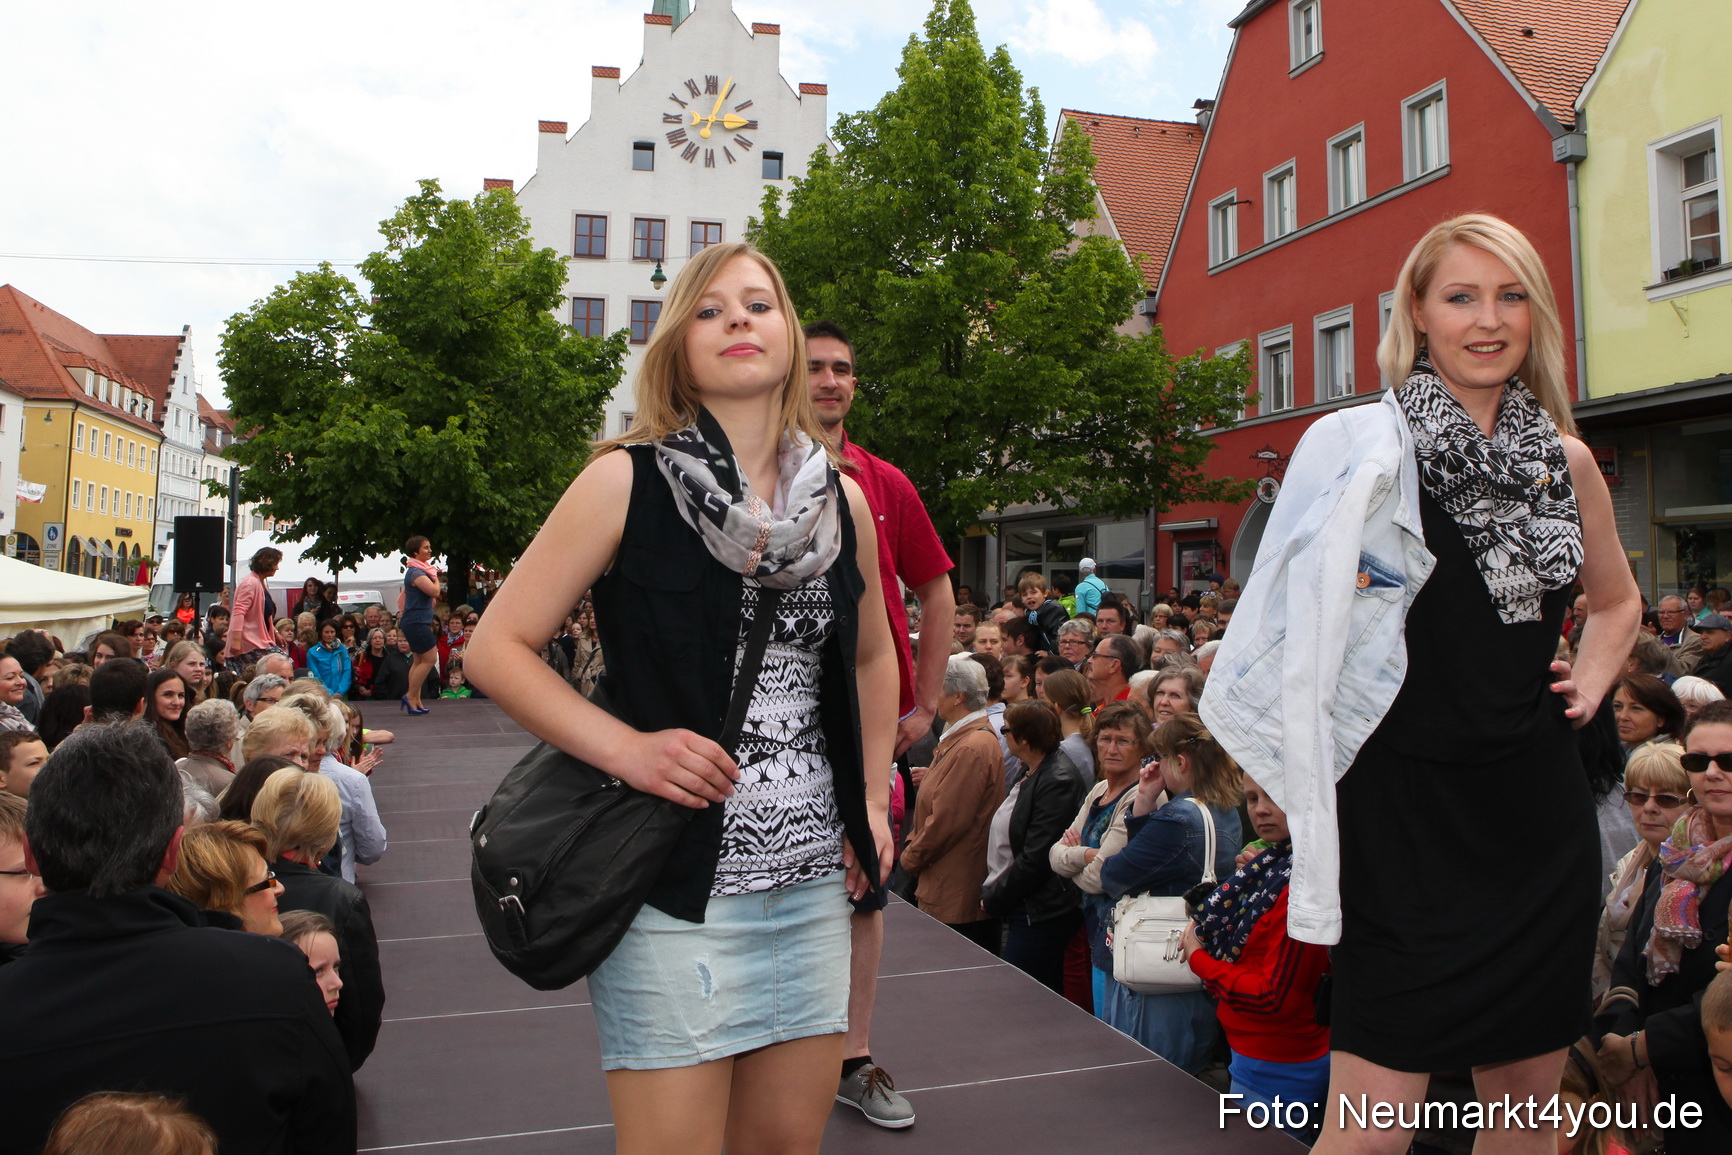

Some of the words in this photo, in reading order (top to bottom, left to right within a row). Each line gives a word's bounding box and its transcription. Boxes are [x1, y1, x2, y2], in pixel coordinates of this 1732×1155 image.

[684, 78, 701, 99] XI
[705, 75, 718, 95] XII
[725, 83, 736, 99] I
[669, 93, 688, 109] X
[734, 100, 753, 112] II
[663, 112, 682, 123] IX
[666, 128, 688, 148] VIII
[734, 134, 753, 151] IV
[681, 141, 700, 163] VII
[705, 148, 715, 168] VI
[723, 146, 736, 164] V
